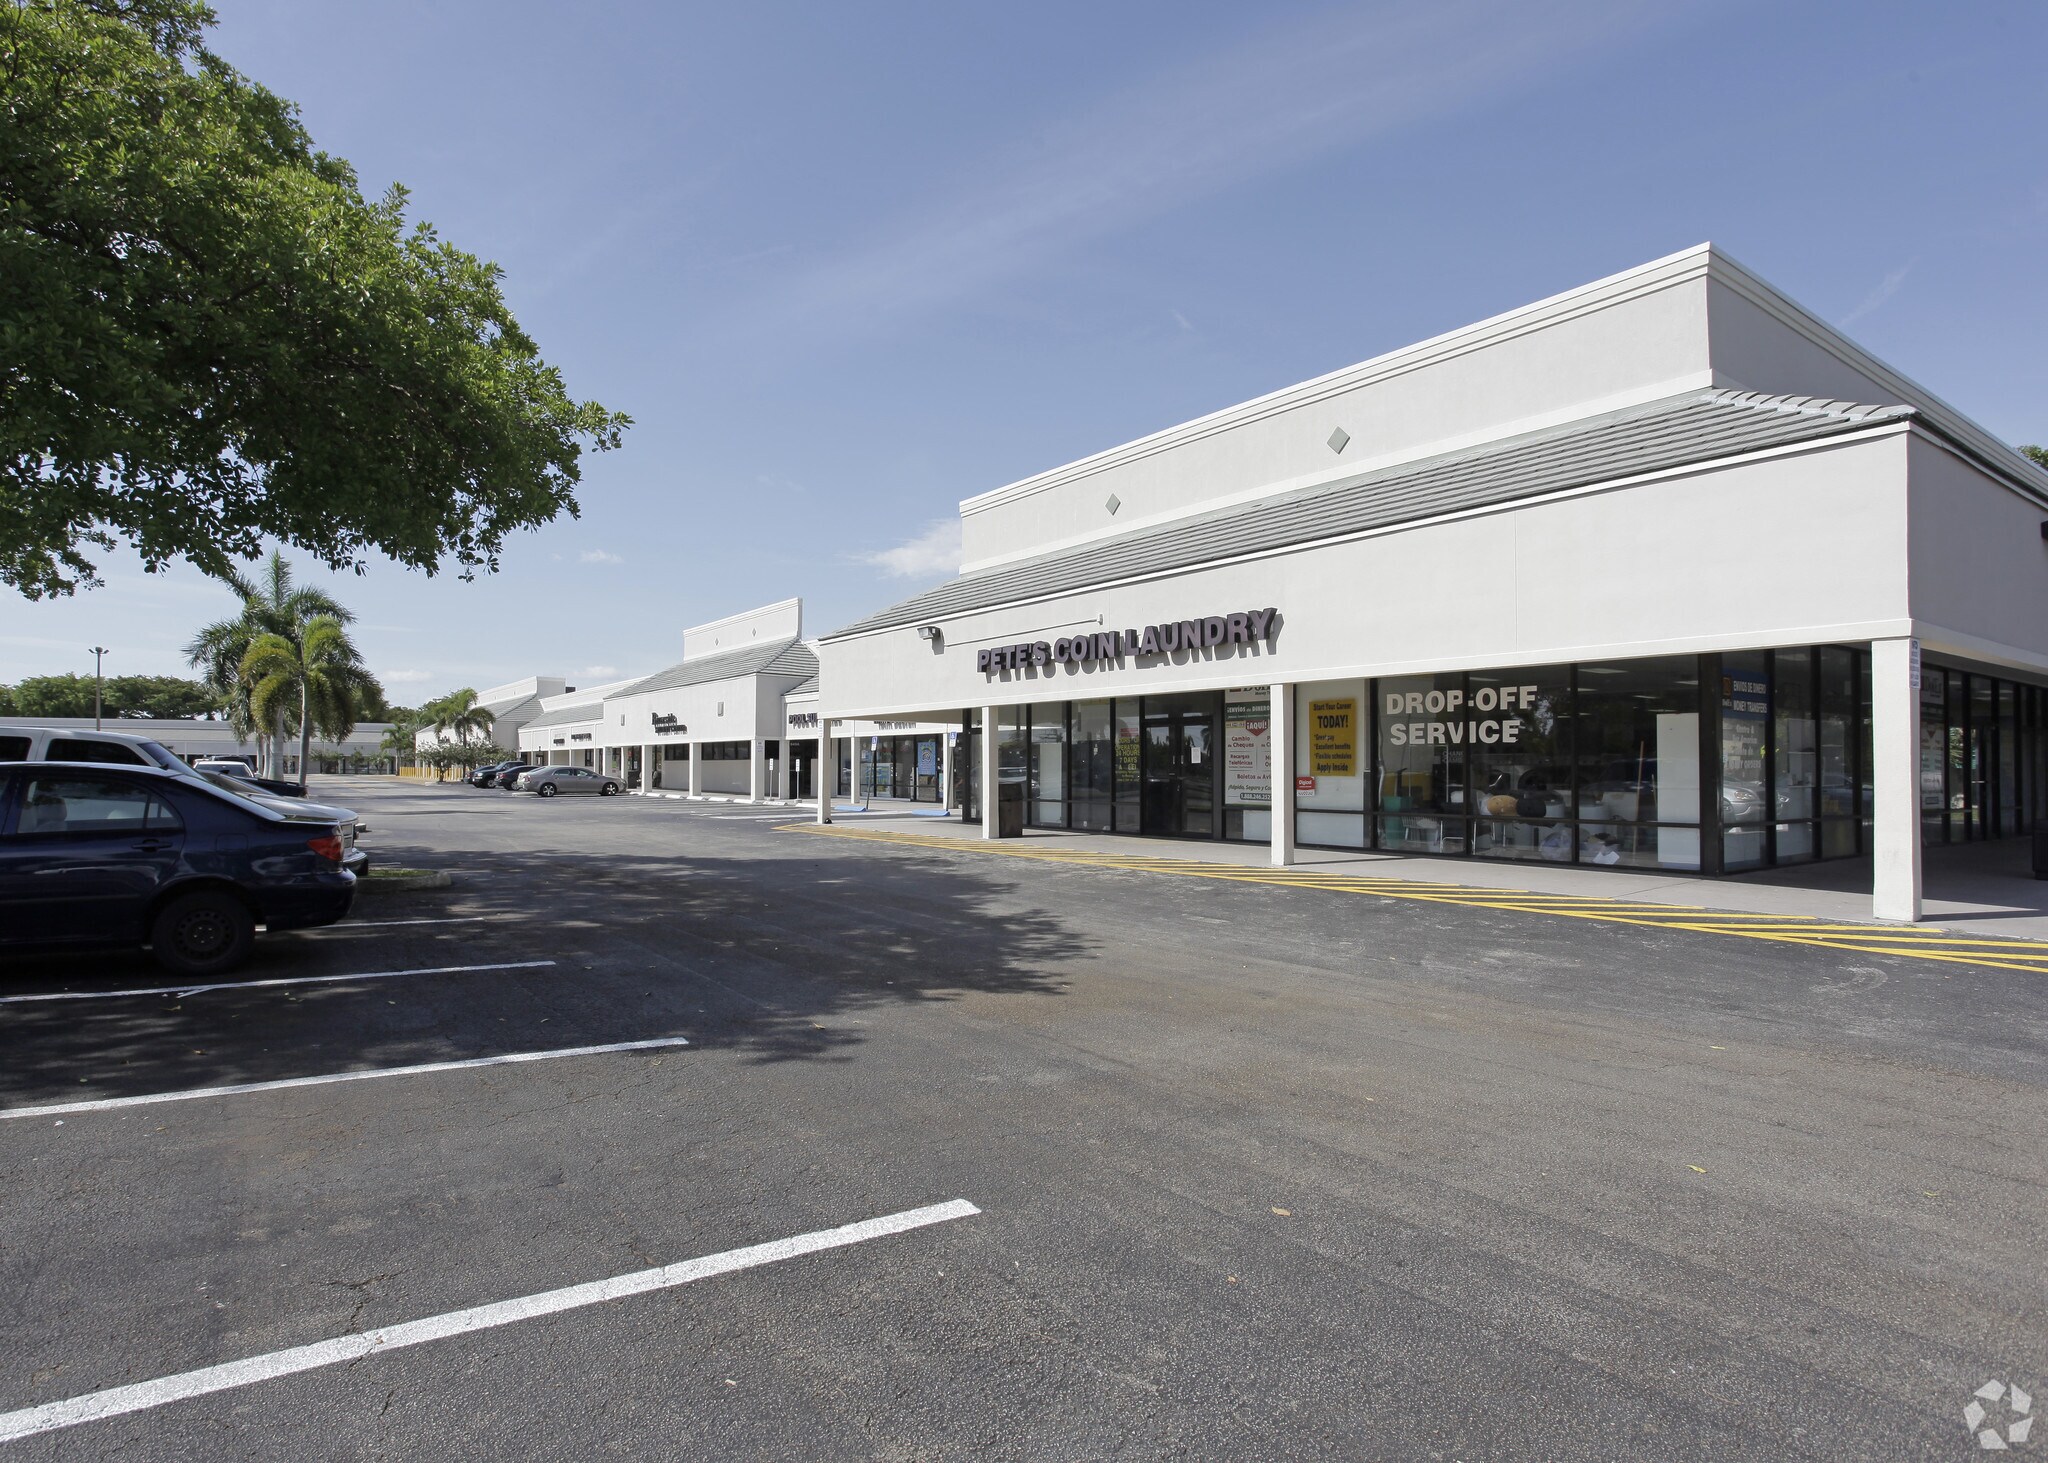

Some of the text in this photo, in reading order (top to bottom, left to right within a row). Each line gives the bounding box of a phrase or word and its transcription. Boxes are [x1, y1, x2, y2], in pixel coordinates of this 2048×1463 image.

[977, 607, 1277, 673] PETE'S COIN LAUNDRY
[1386, 685, 1538, 715] DROP-OFF
[1317, 714, 1349, 729] TODAY!
[1390, 720, 1521, 745] SERVICE
[1317, 762, 1331, 773] Apply
